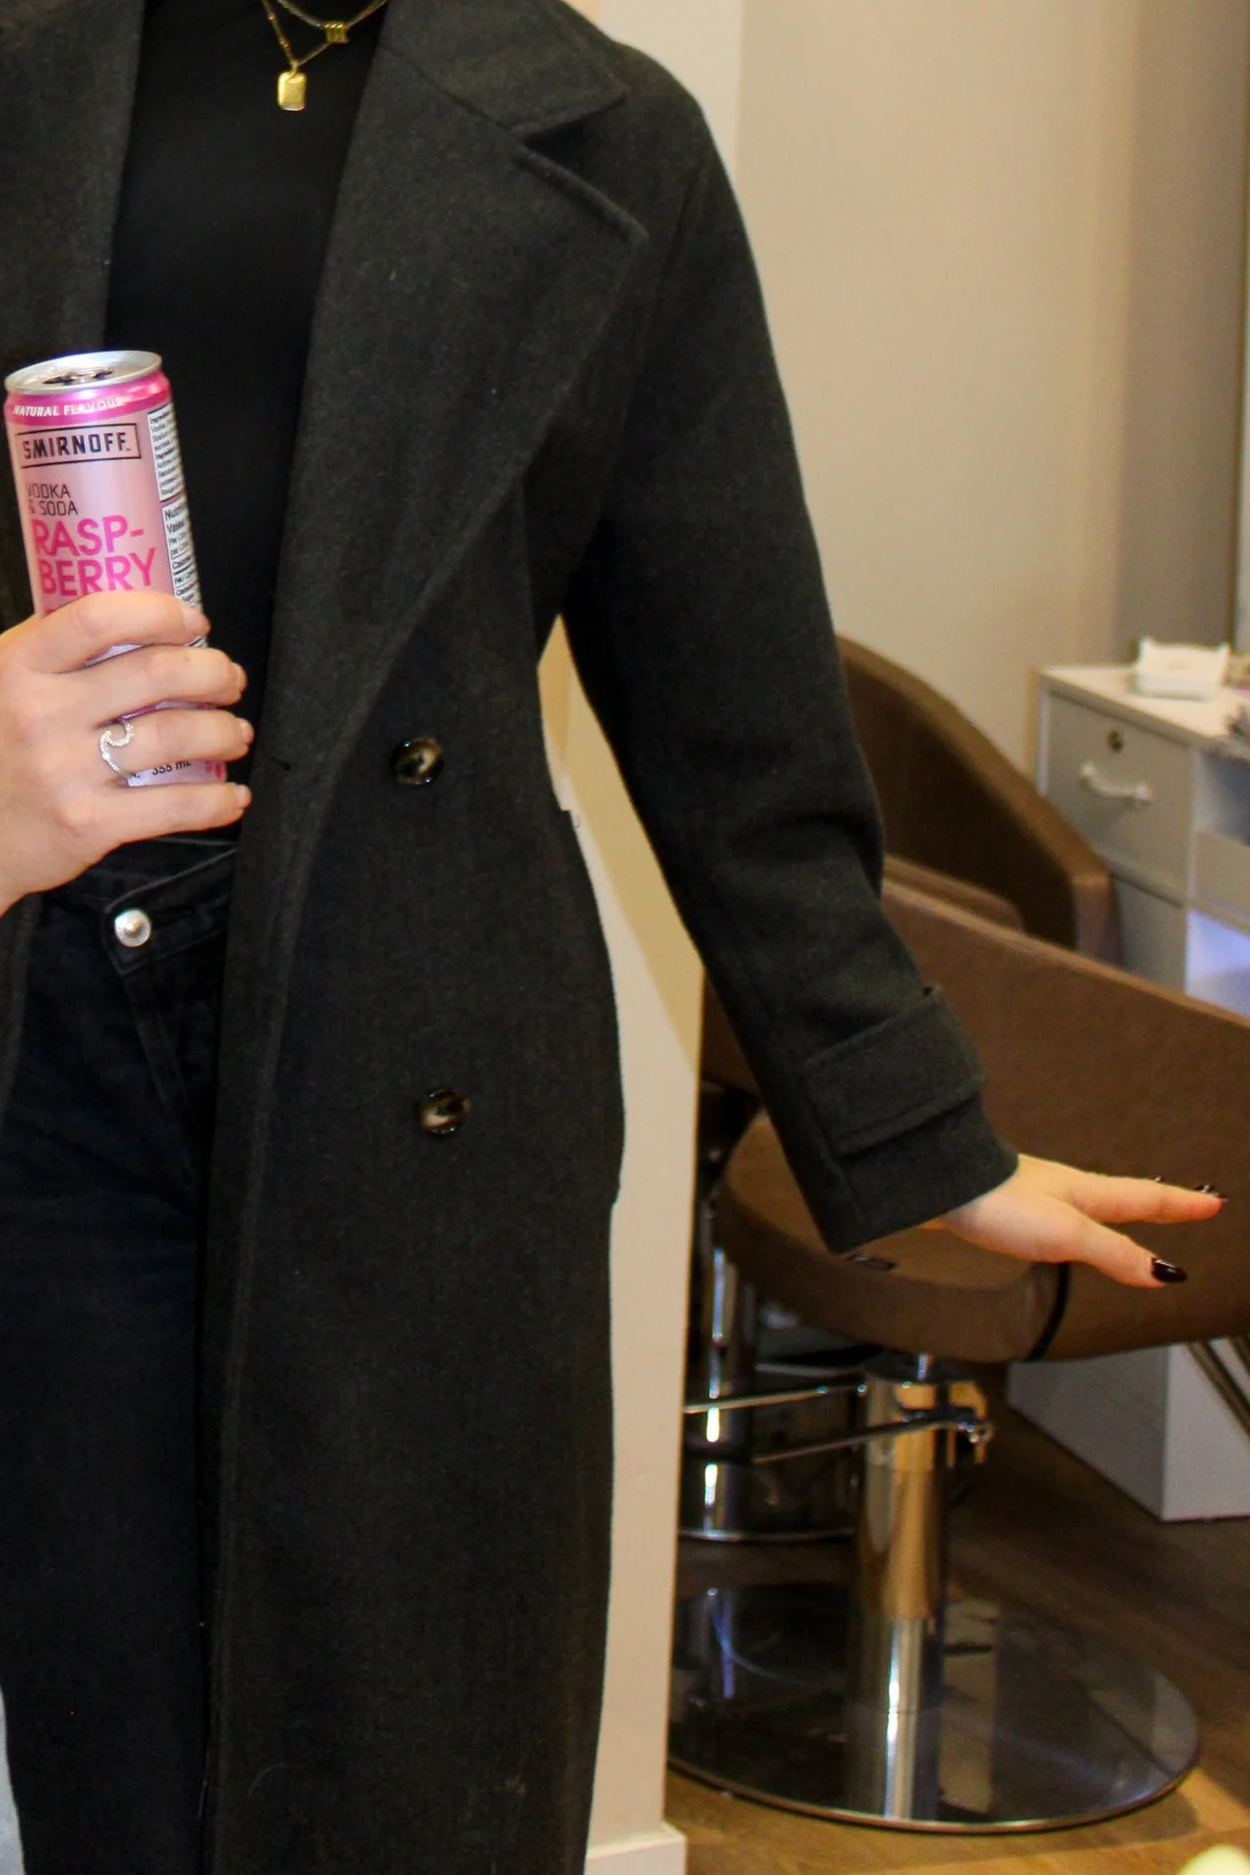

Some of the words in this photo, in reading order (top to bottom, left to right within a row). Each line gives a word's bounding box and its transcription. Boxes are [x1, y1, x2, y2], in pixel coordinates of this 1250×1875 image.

[13, 404, 59, 417] NATURAL
[63, 396, 125, 416] FLAVOUR
[22, 432, 126, 460] SMIRNOFF
[24, 483, 72, 499] VODKA
[39, 499, 79, 516] SODA
[31, 514, 145, 557] RASP-
[37, 547, 156, 597] BERRY
